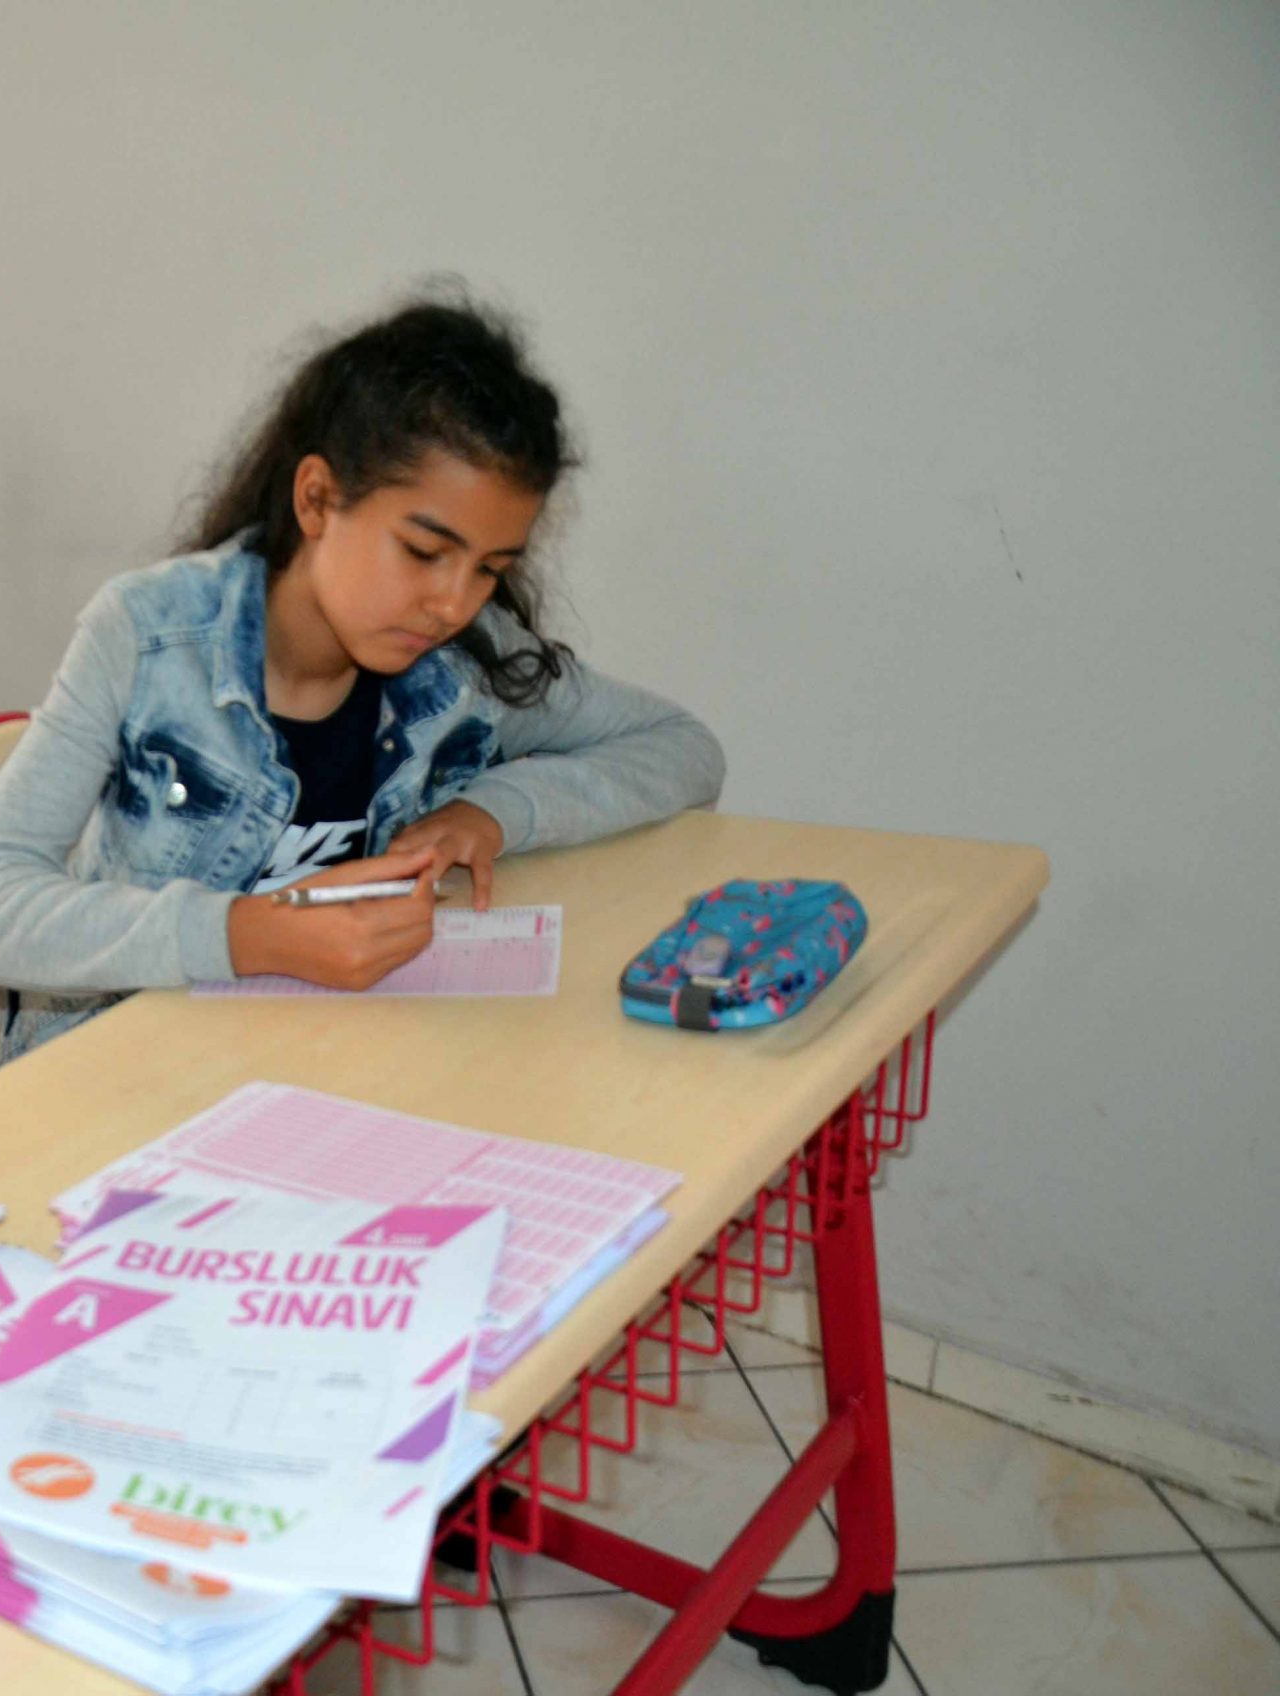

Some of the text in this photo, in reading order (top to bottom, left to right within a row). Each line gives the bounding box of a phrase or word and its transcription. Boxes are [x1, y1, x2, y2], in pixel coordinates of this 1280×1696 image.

[115, 1239, 428, 1287] BURSLULUK
[52, 1293, 98, 1330] A
[228, 1289, 415, 1331] SINAVI
